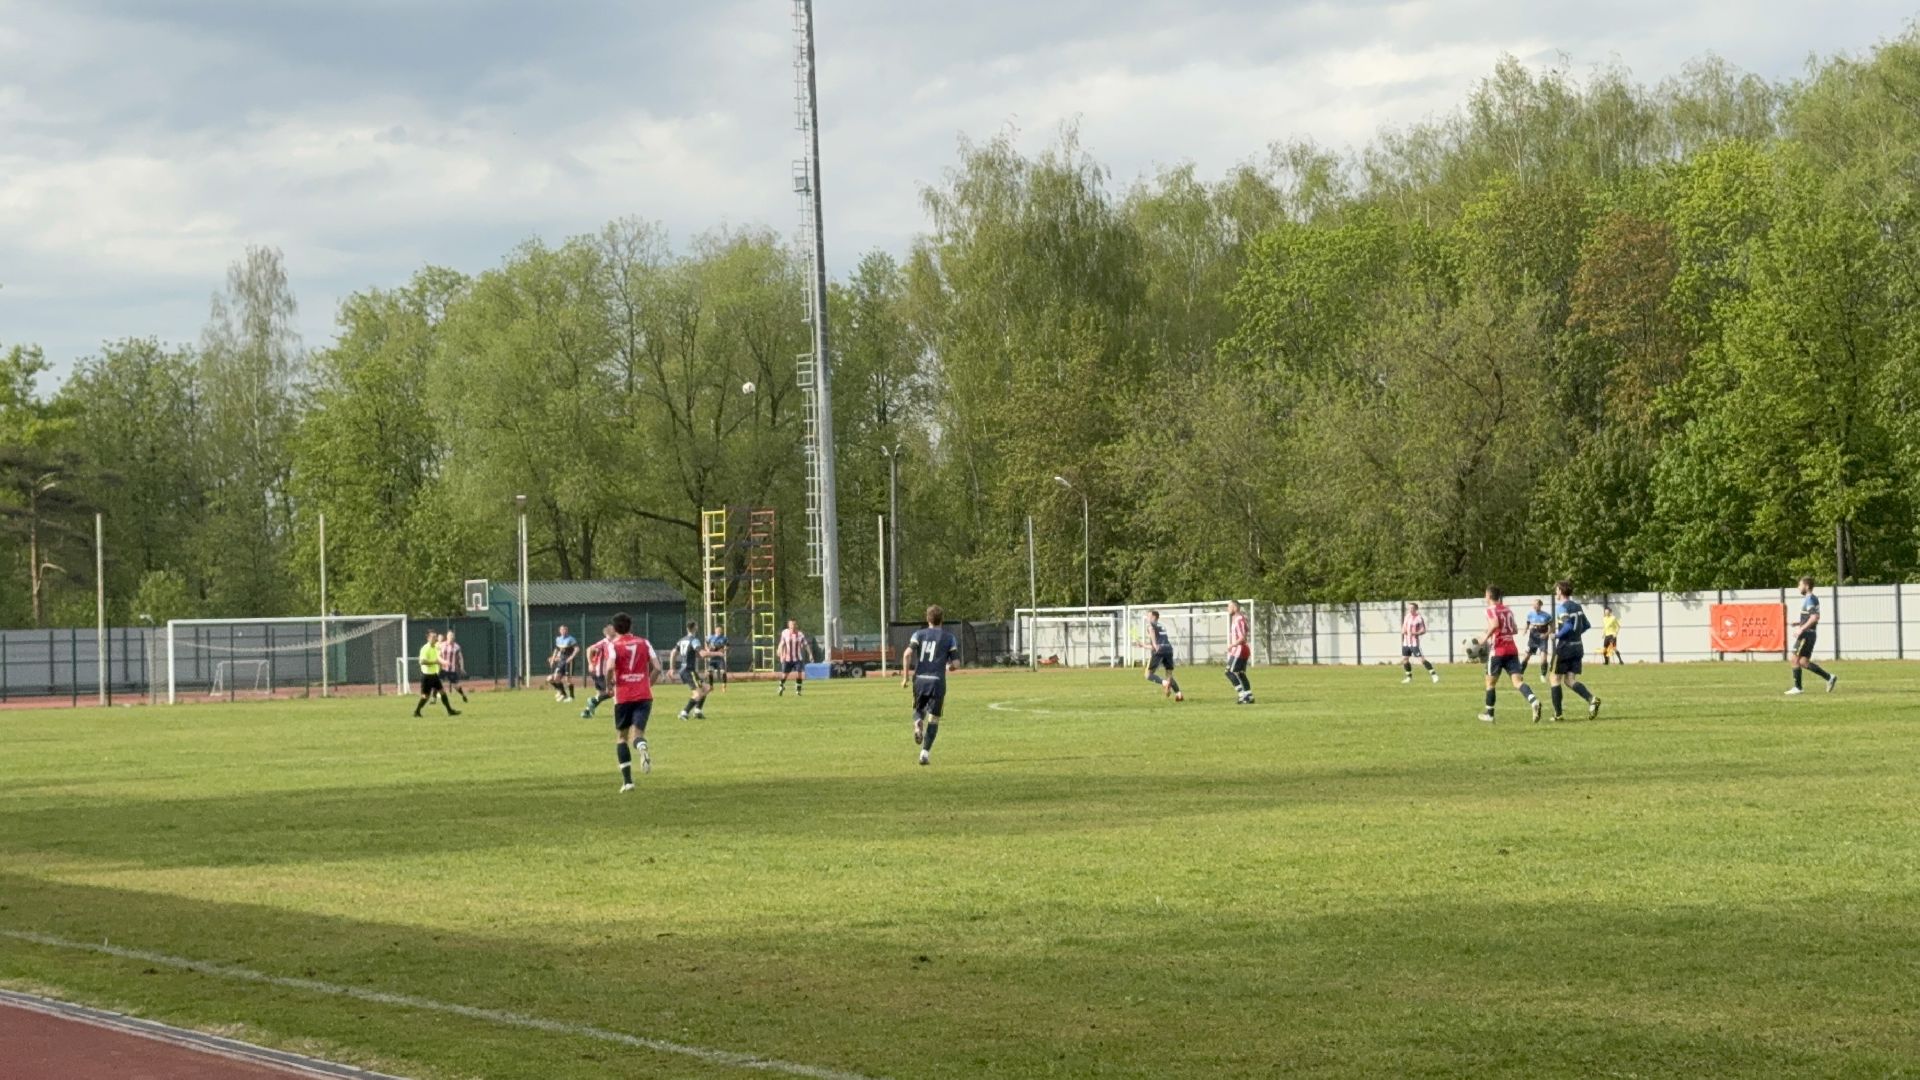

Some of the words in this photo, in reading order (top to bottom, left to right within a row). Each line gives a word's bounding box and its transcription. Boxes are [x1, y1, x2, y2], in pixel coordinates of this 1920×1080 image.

[1500, 610, 1515, 634] 20
[625, 643, 638, 671] 7
[919, 640, 937, 663] 14
